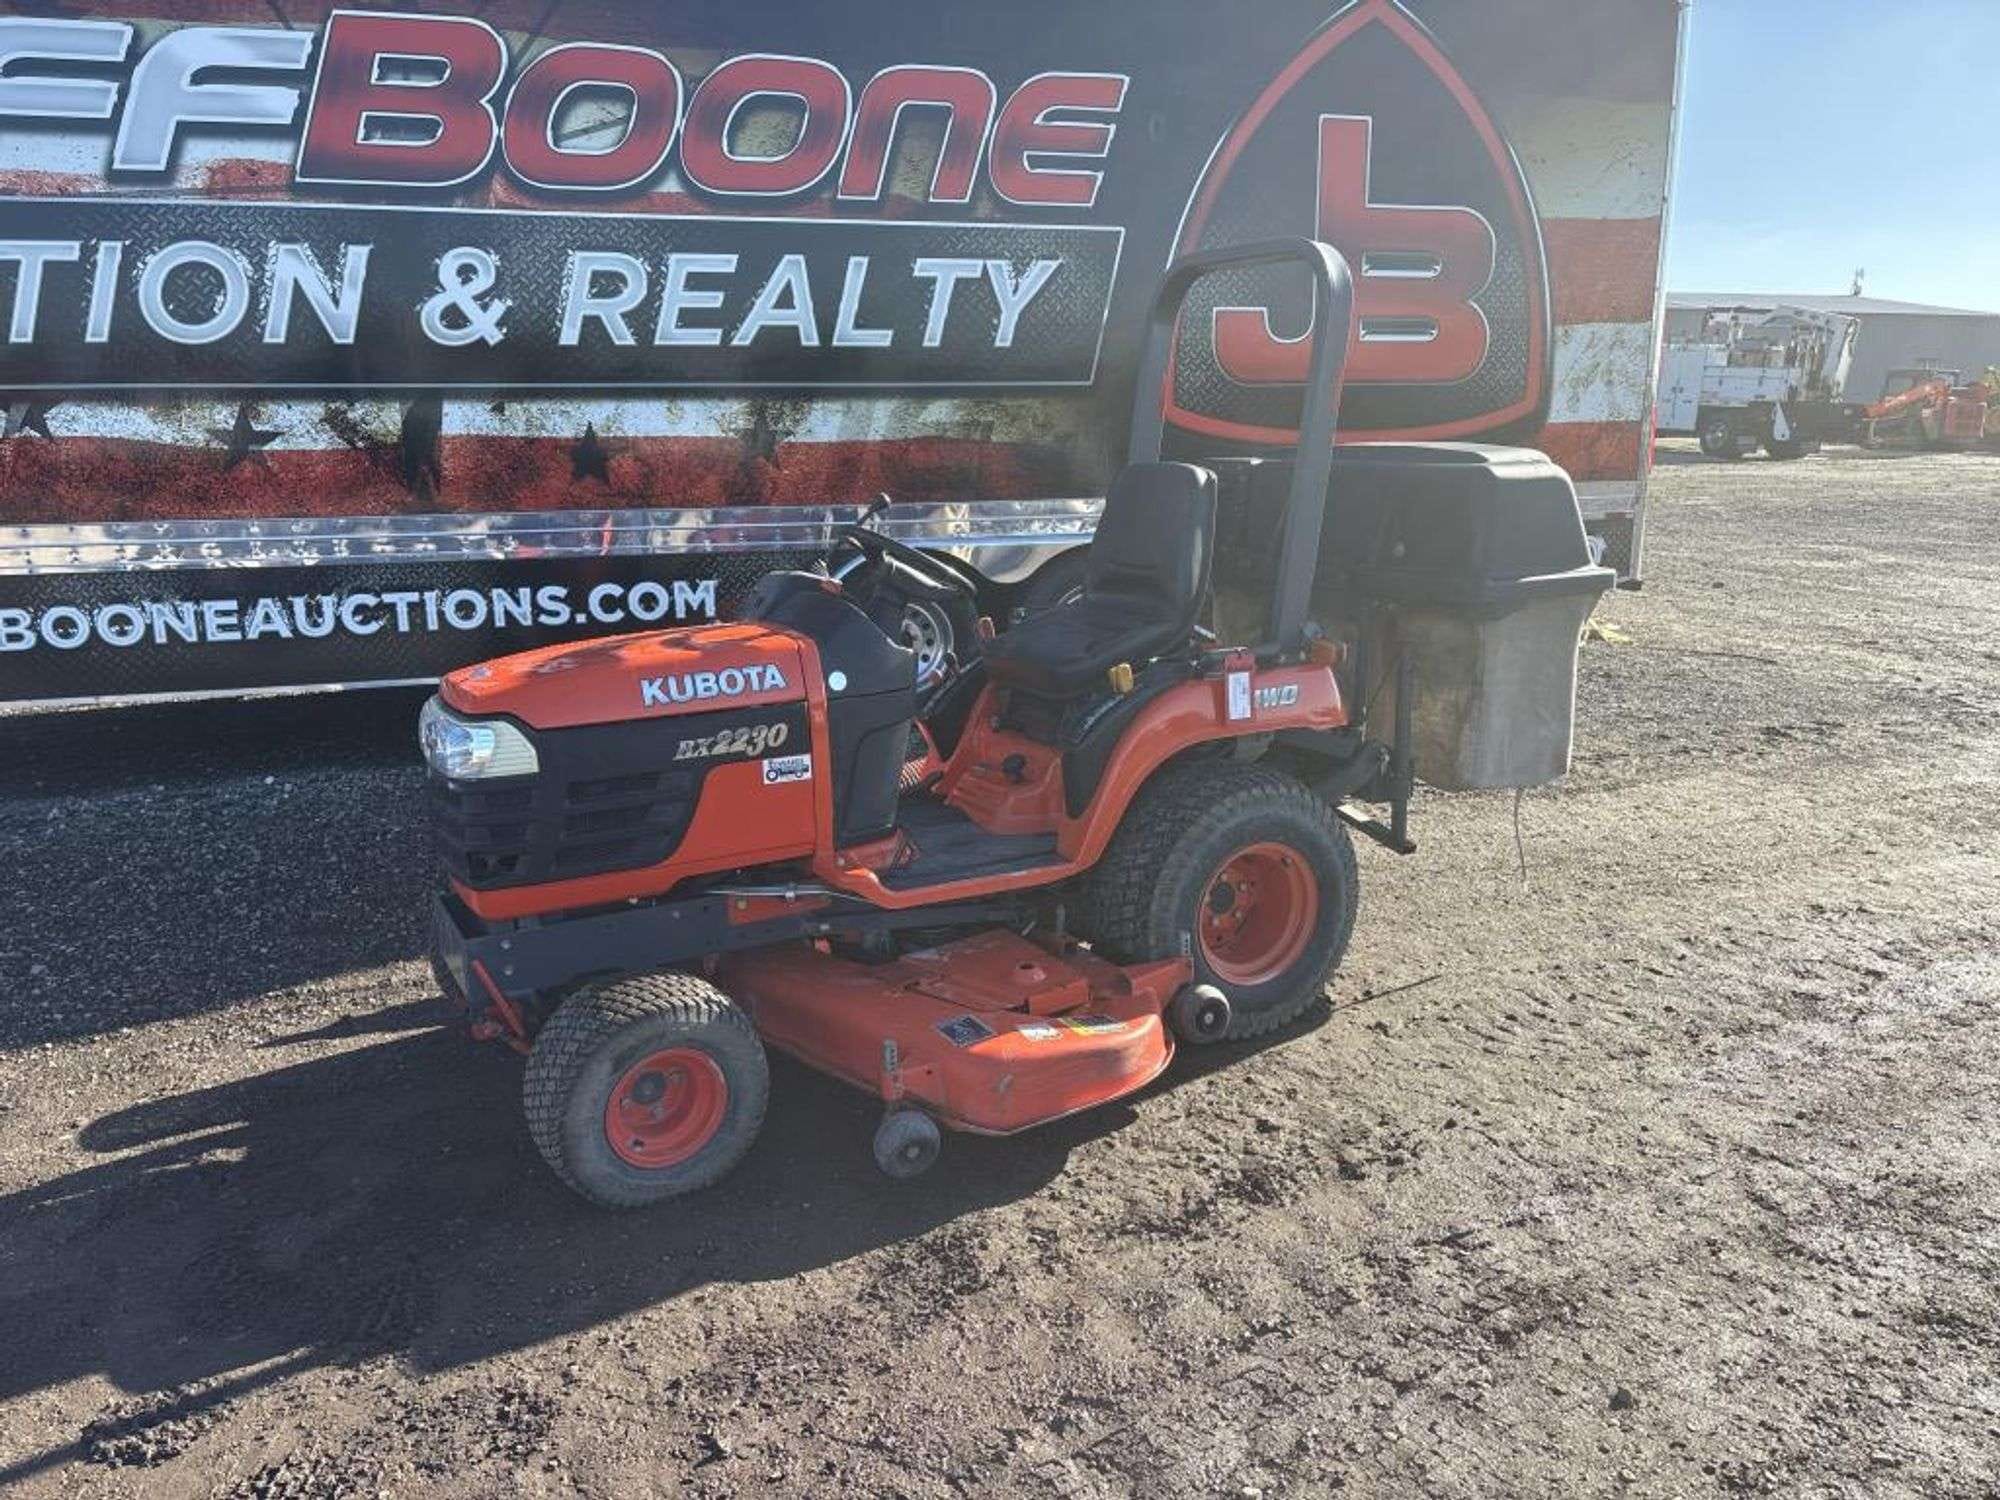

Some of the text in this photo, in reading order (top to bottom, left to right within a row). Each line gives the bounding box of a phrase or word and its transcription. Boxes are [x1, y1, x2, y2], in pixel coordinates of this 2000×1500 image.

[0, 239, 1064, 348] TION & REALTY
[0, 579, 717, 652] BOONEAUCTIONS.COM
[640, 663, 788, 707] KUBOTA
